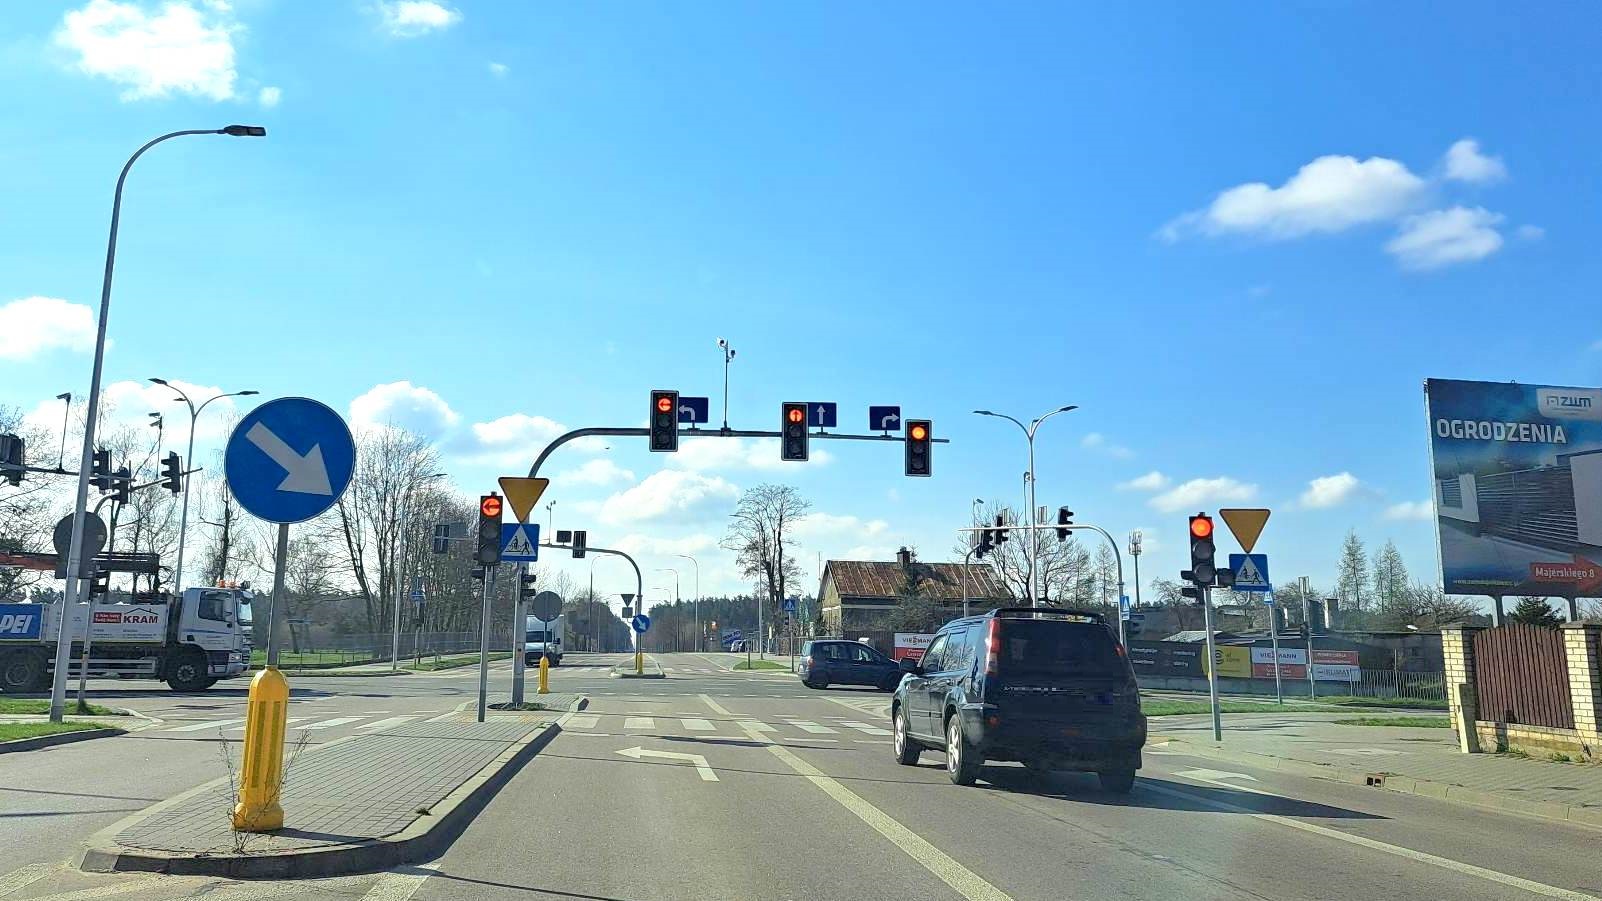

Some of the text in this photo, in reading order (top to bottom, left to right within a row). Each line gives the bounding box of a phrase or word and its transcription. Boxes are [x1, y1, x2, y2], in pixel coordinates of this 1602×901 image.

[1436, 418, 1567, 444] OGRODZENIA
[1535, 566, 1595, 579] Majerskiego 8
[123, 615, 159, 624] KRAM
